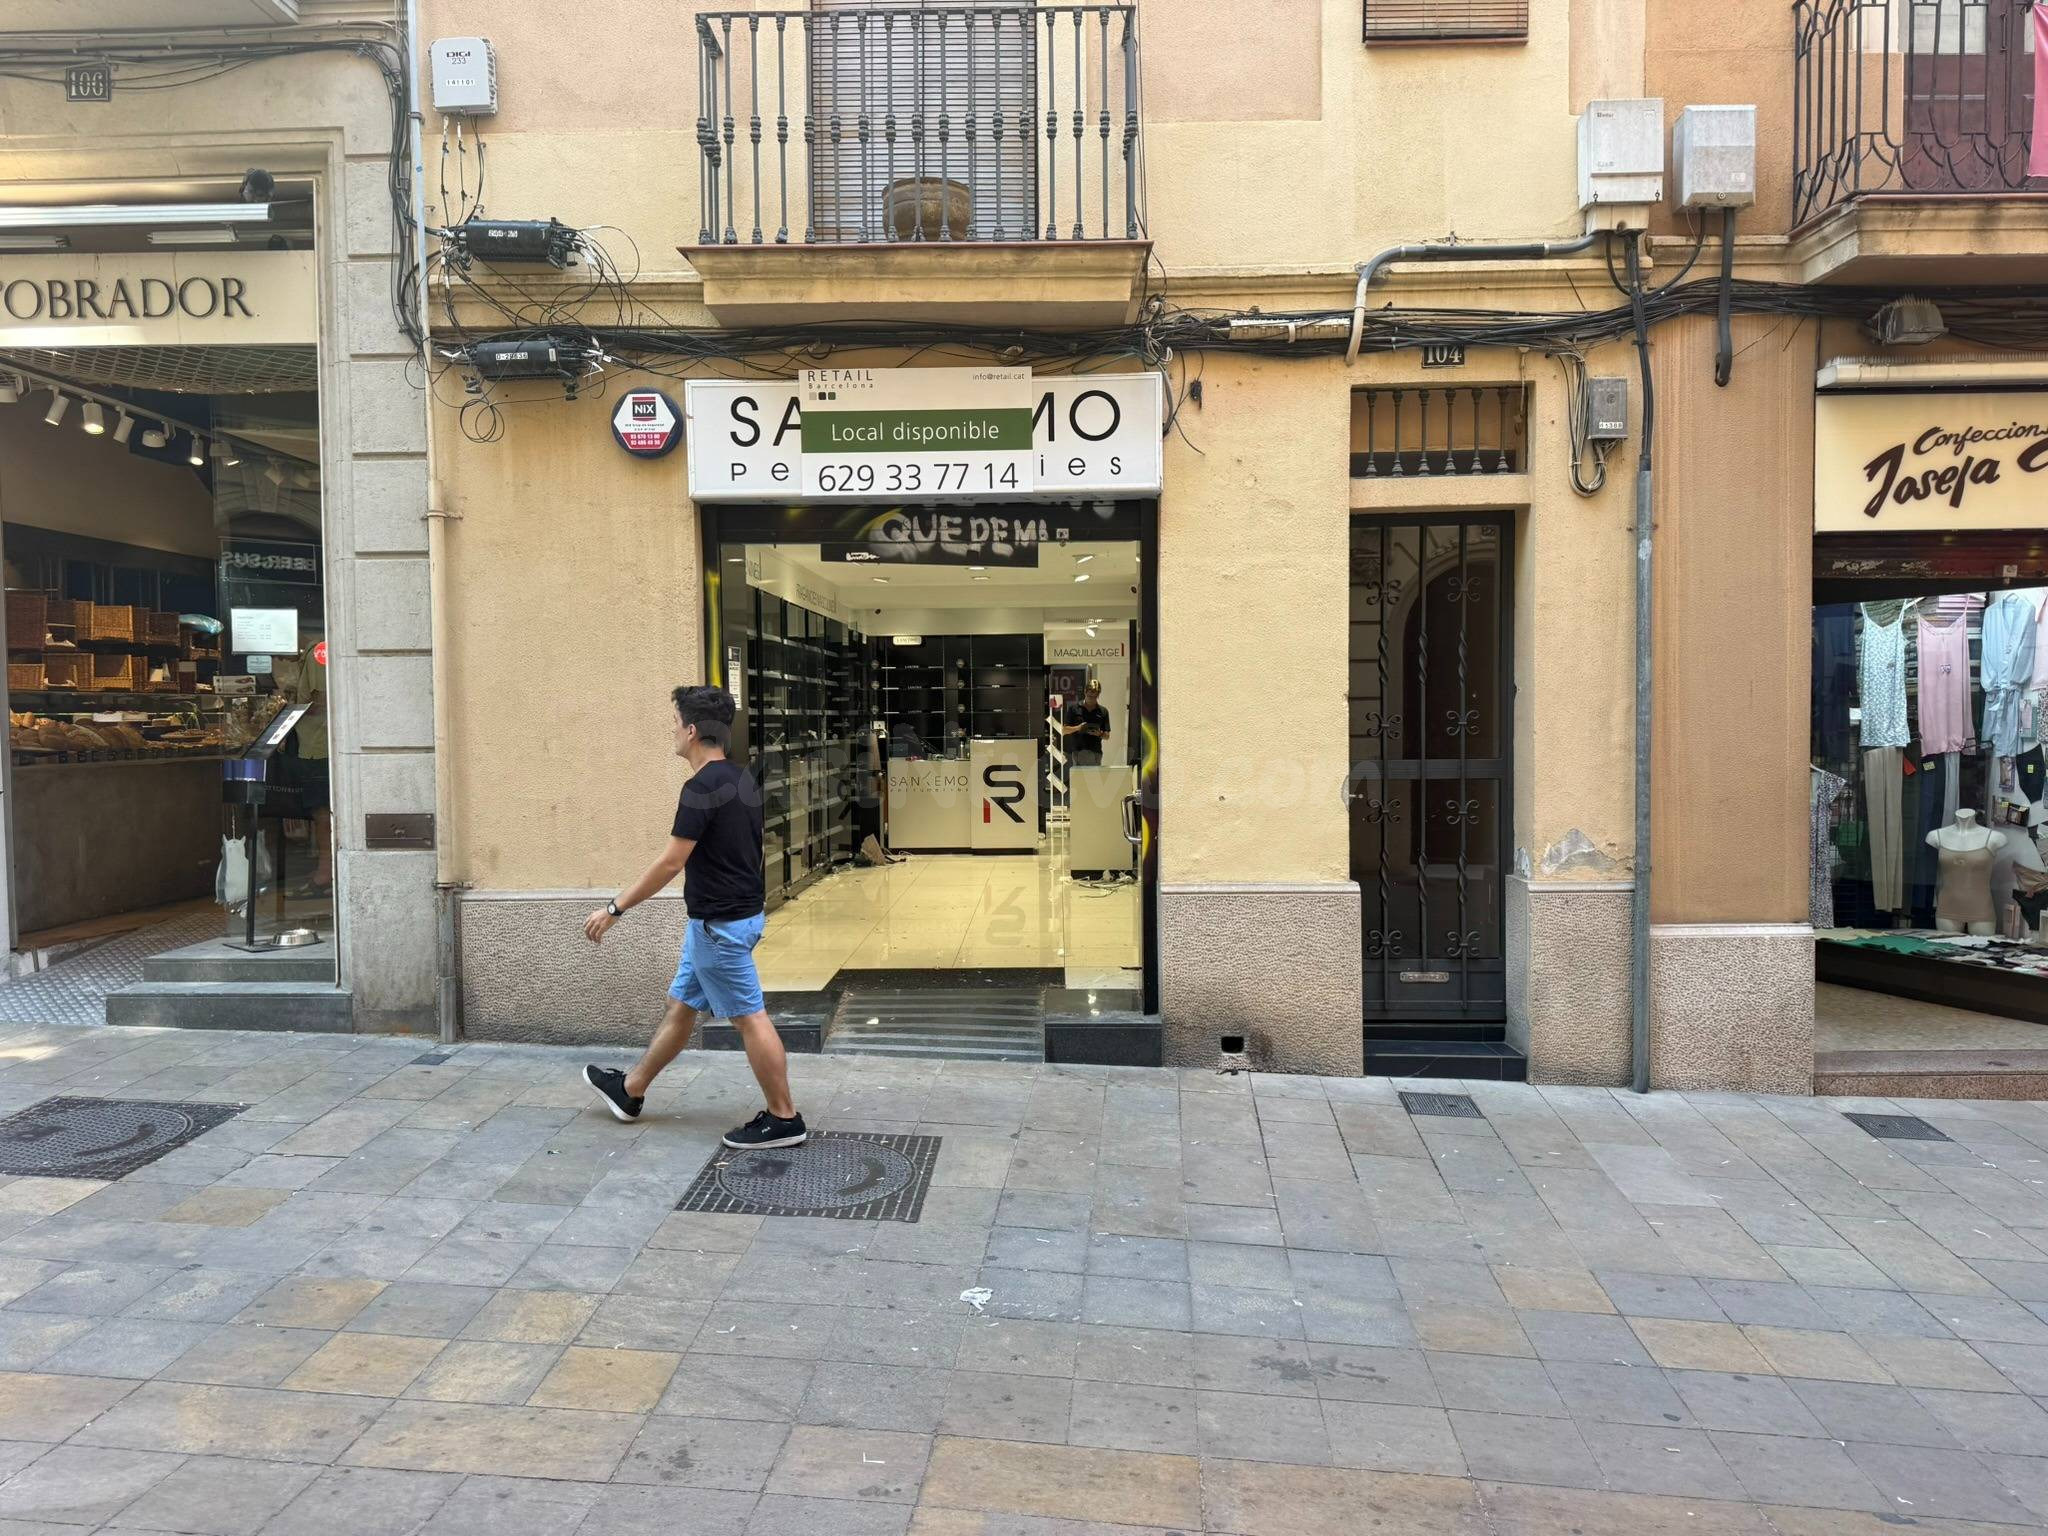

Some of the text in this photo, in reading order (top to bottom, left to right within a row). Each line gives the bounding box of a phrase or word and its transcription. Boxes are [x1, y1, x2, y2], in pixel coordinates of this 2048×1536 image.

[451, 57, 467, 65] 233
[71, 71, 104, 96] 106
[1427, 344, 1462, 363] 104
[807, 369, 873, 382] RETAIL
[972, 372, 1025, 381] info@retail.cat
[808, 382, 874, 390] Barcelona
[634, 404, 655, 414] NIX
[832, 420, 1000, 445] Local disponible
[1913, 422, 2048, 456] Confeccion
[818, 464, 875, 493] 629
[885, 463, 922, 491] 33
[933, 463, 969, 490] 77
[984, 462, 1019, 490] 14
[1053, 647, 1120, 658] MAQUILLATGE
